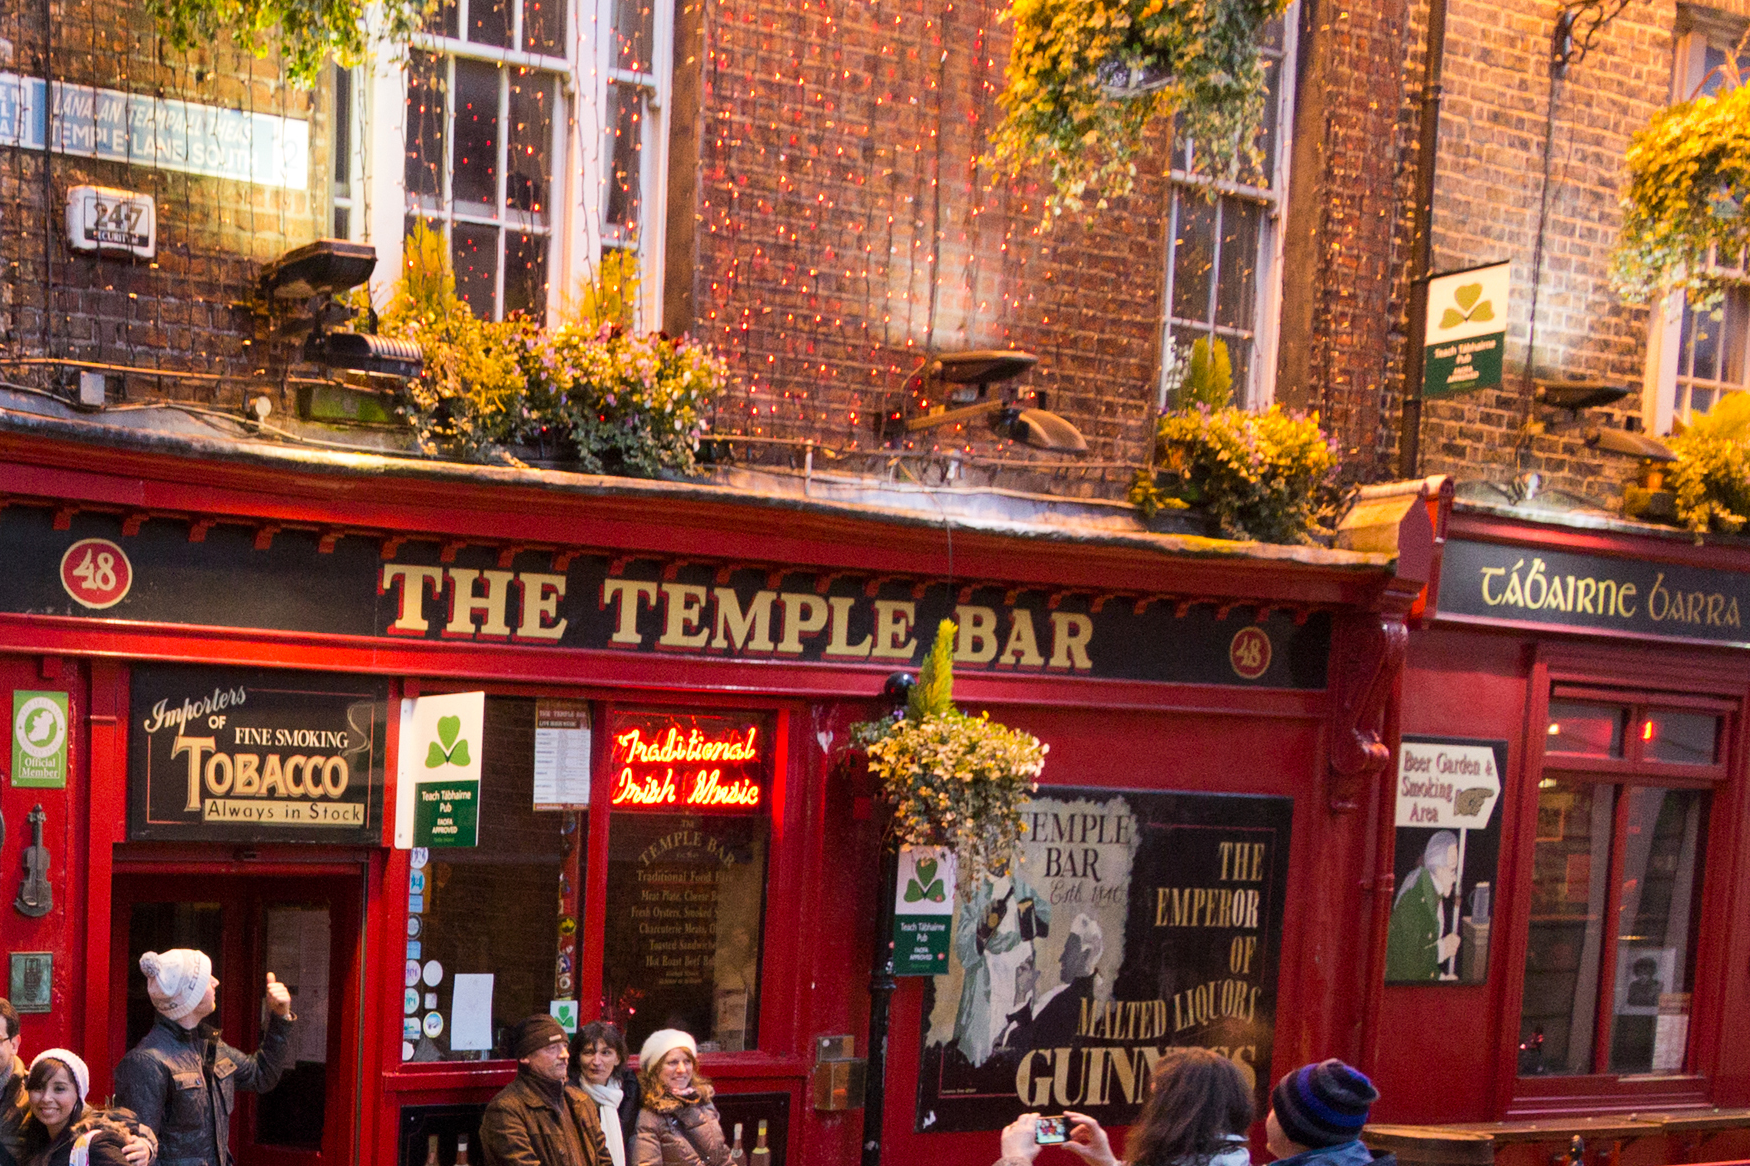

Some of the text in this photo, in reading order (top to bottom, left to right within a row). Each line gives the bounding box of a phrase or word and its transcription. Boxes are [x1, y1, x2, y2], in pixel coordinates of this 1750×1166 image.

[100, 101, 123, 124] AN
[51, 120, 259, 173] TEMPLE LANE SOUTH
[72, 549, 117, 591] 48
[381, 563, 1095, 671] THE TEMPLE BAR
[1236, 635, 1262, 668] 48
[144, 686, 247, 735] Importers
[208, 715, 227, 730] OF
[235, 727, 349, 749] FINE SMOKING
[619, 727, 757, 764] Traditional
[22, 767, 58, 778] Member
[24, 757, 56, 768] Official
[170, 735, 349, 813] TOBACCO
[1403, 750, 1432, 773] Beer
[1436, 752, 1480, 776] Garden
[422, 791, 440, 801] Teach
[612, 767, 760, 805] Irish Music
[1401, 776, 1453, 803] Smoking
[207, 801, 361, 821] Always in Stock
[439, 803, 452, 813] Pub
[1410, 802, 1439, 823] Area
[637, 830, 703, 868] TEMPLE
[1043, 847, 1102, 883] BAR
[1219, 841, 1265, 881] THE
[1154, 887, 1260, 929] EMPEROR
[916, 933, 929, 942] Pub
[1229, 936, 1257, 974] OF
[1076, 979, 1262, 1040] MALTED LIQUORS
